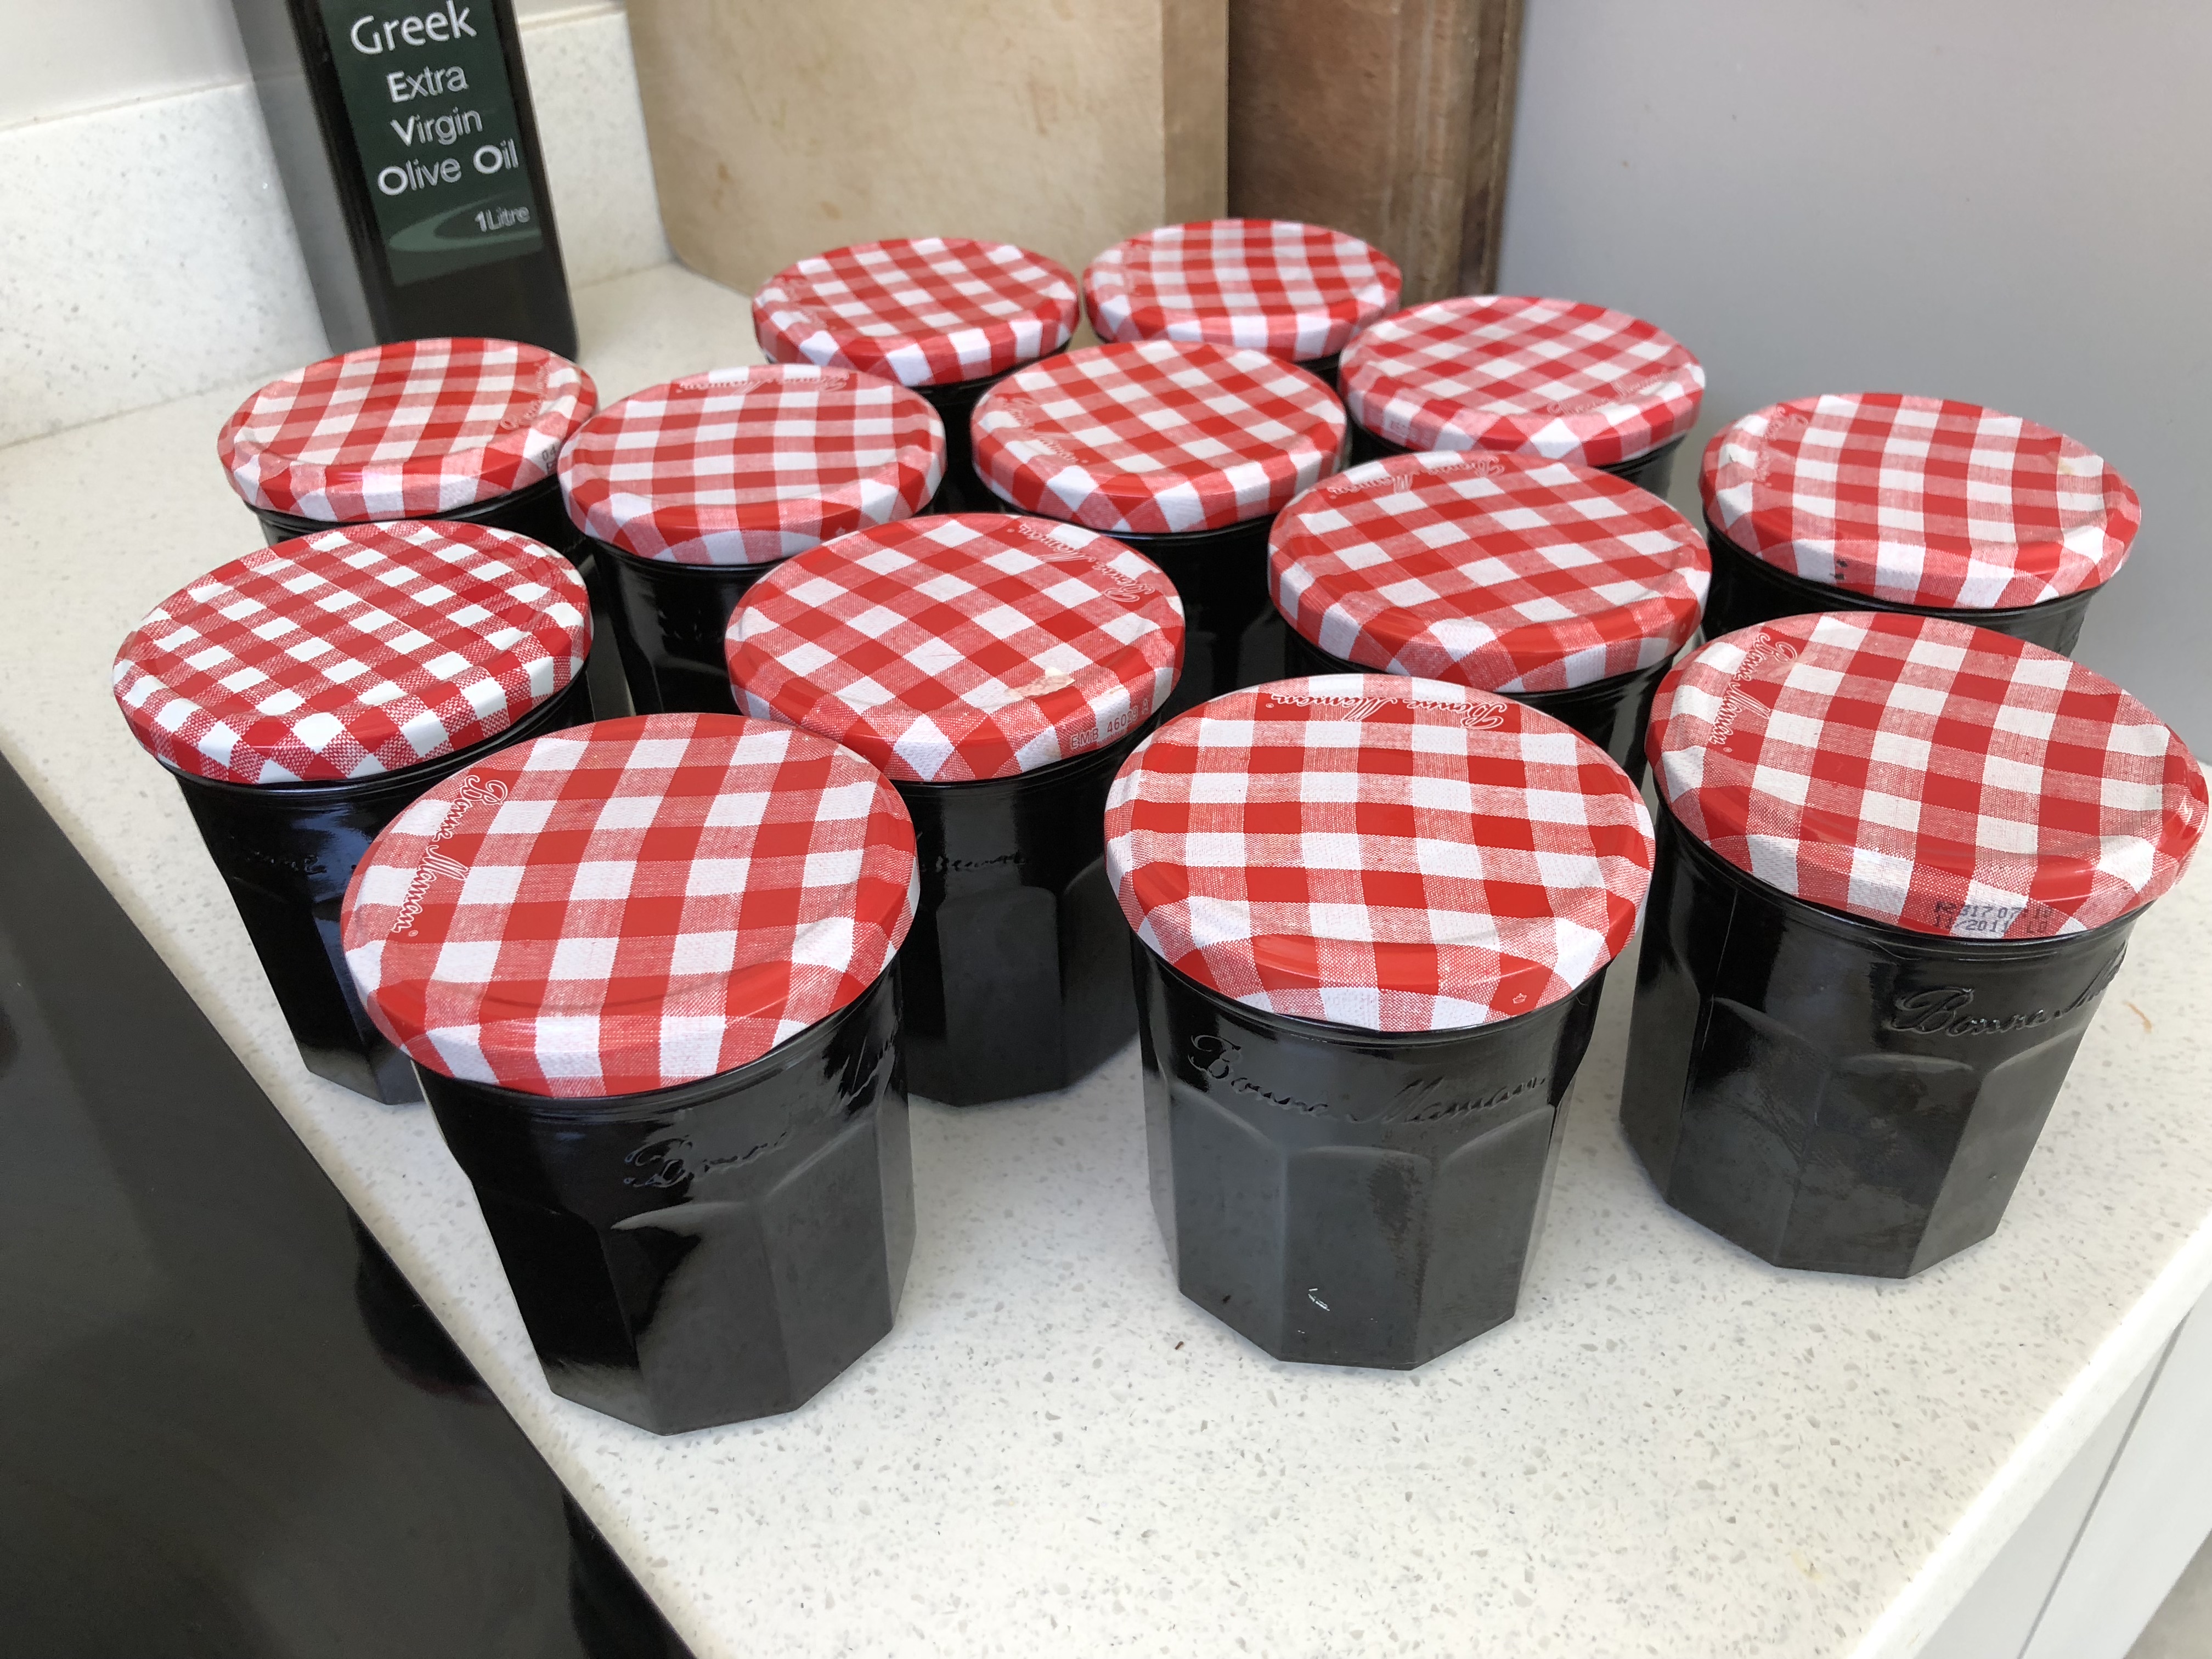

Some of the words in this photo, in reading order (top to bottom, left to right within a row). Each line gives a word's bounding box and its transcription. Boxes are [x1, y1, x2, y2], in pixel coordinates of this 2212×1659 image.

[351, 0, 477, 54] Greek
[387, 65, 469, 103] Extra
[390, 107, 483, 146] Virgin
[377, 158, 462, 196] Olive
[473, 138, 518, 174] Oil
[1018, 523, 1097, 563] Maman
[1092, 561, 1155, 603] Bonne
[1733, 633, 1798, 682] Bonne
[1070, 726, 1099, 750] EMB
[1107, 706, 1139, 733] 46029
[1142, 698, 1149, 715] A
[1271, 693, 1398, 722] Maman
[1402, 698, 1508, 730] Bonne
[1708, 681, 1771, 745] Maman
[431, 774, 509, 843] Bonne
[390, 844, 470, 934] Maman
